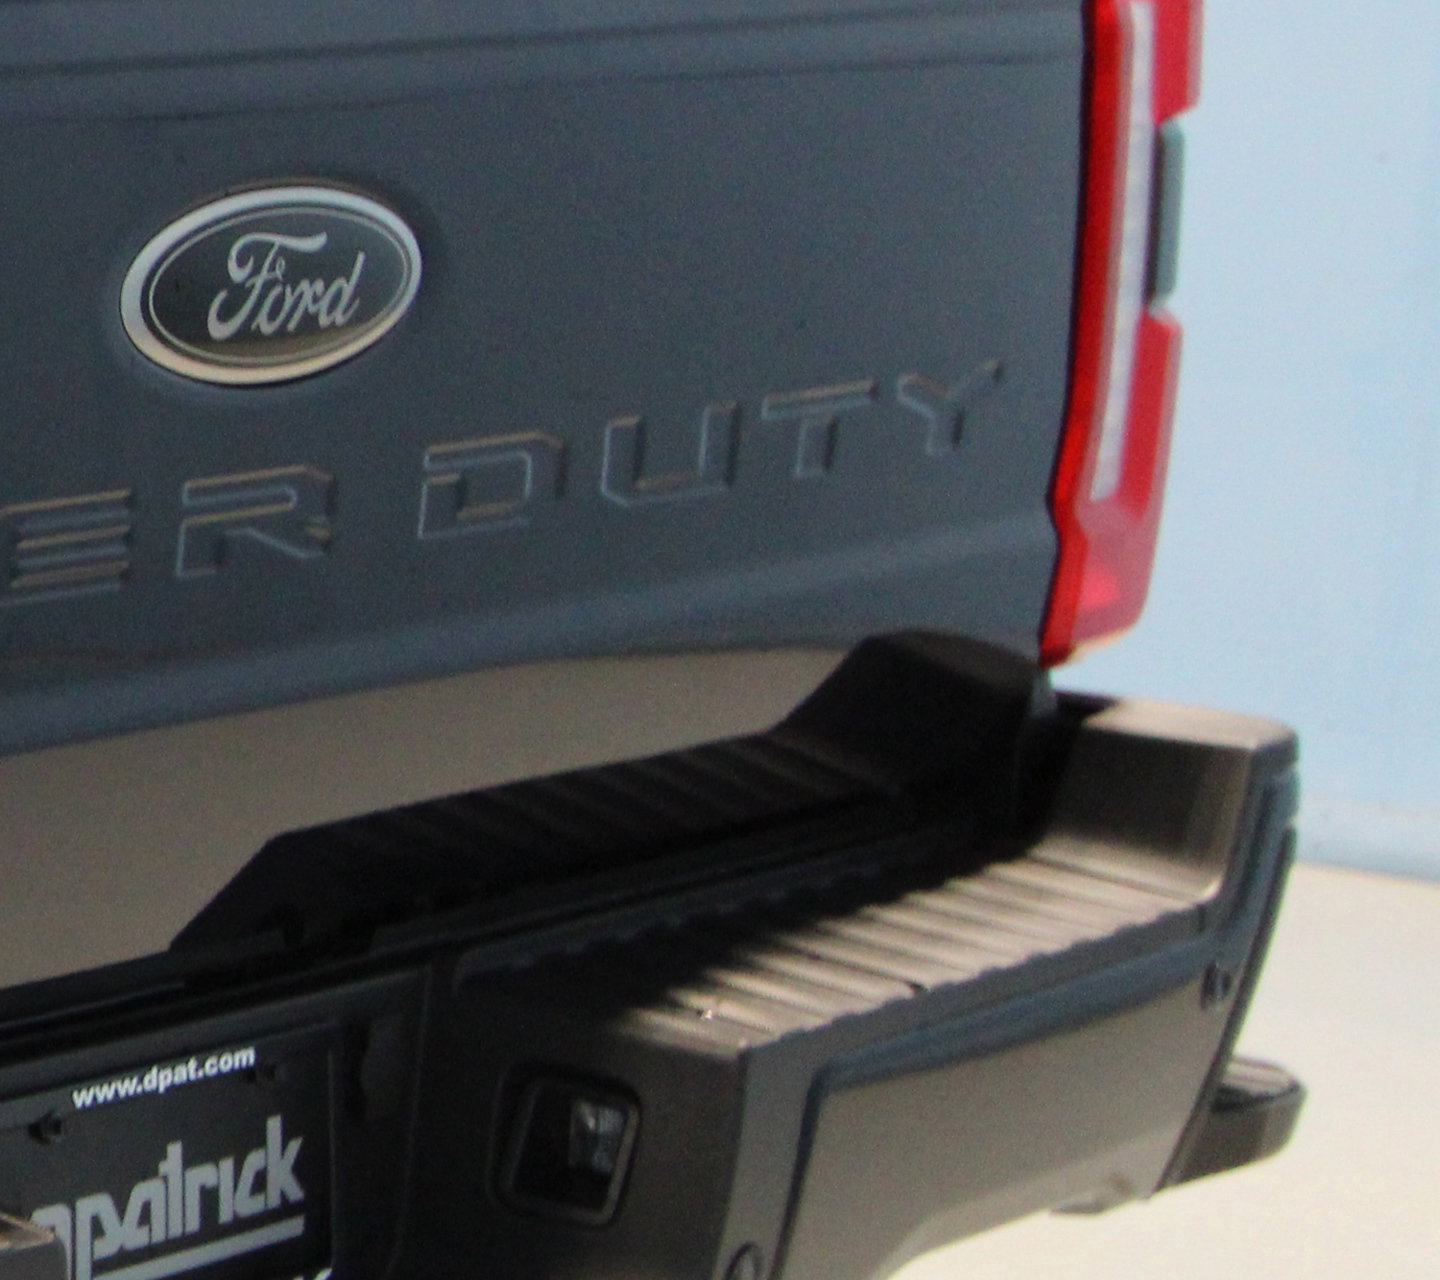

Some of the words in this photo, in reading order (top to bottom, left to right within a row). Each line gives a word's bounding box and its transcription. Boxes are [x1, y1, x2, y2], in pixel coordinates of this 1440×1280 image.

[206, 231, 366, 342] Ford
[417, 359, 1004, 540] DUTY
[71, 1046, 257, 1110] www.dpat.com
